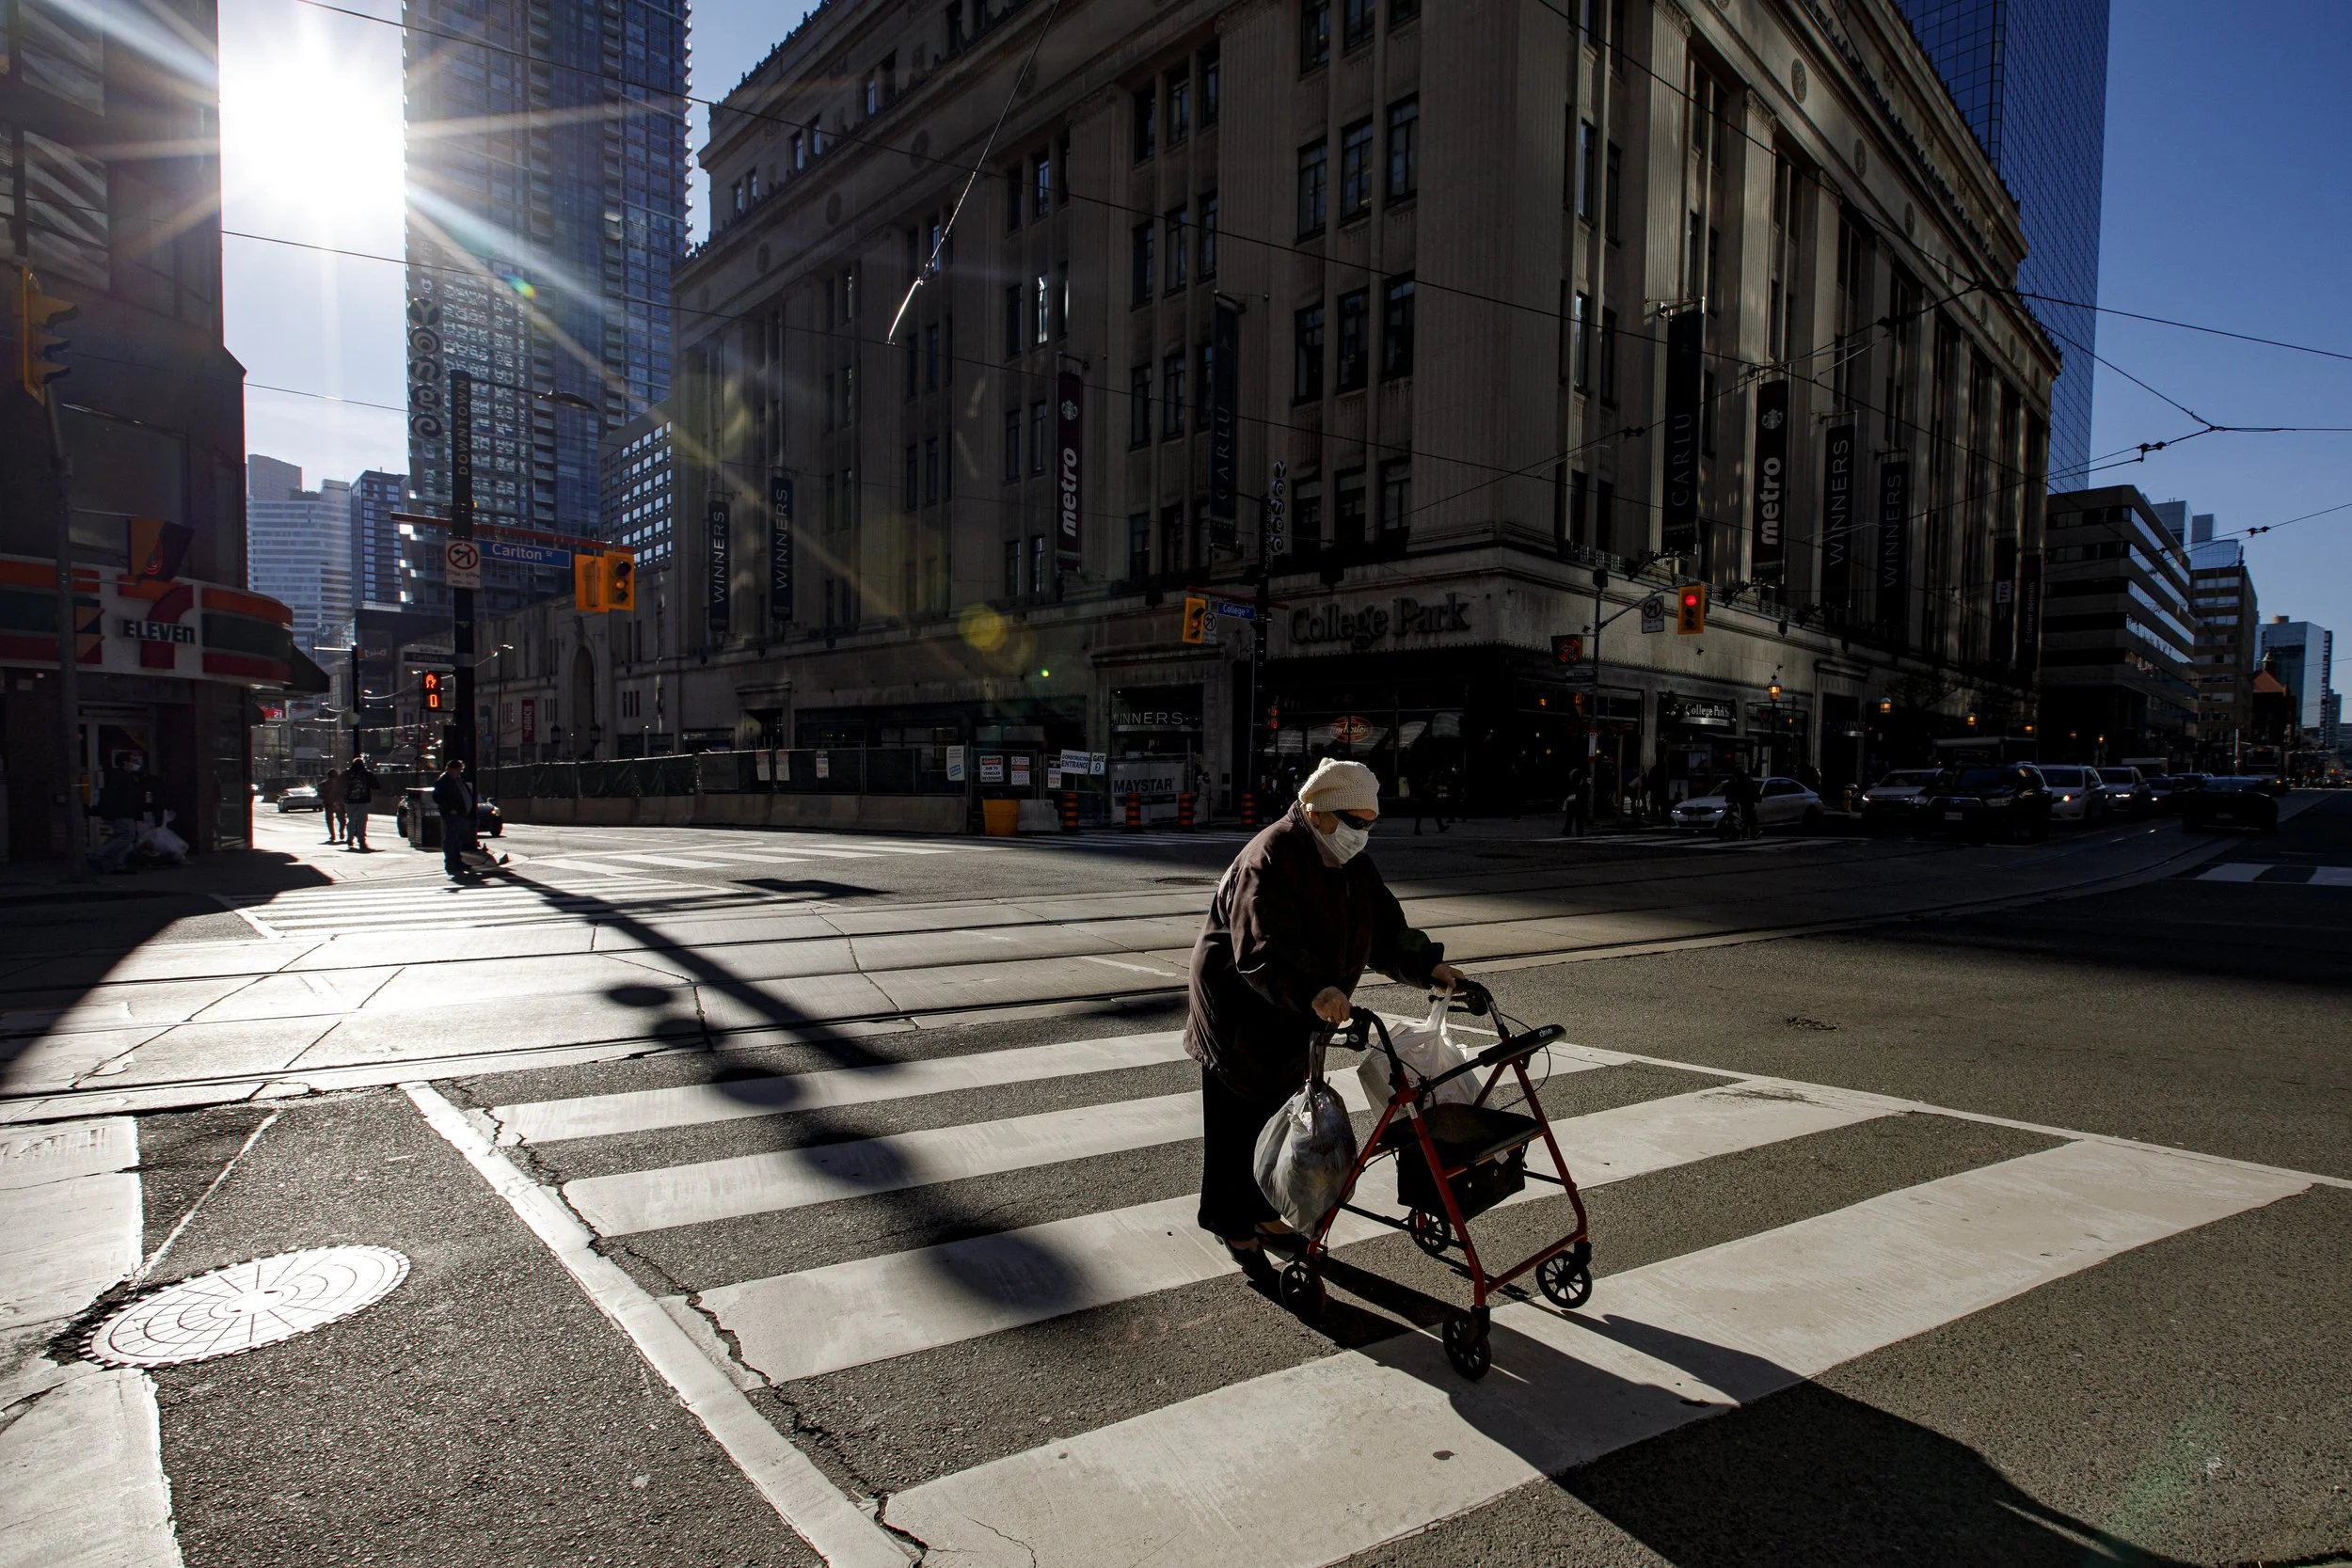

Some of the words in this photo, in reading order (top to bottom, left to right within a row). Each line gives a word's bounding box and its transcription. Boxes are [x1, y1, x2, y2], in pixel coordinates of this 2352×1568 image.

[457, 379, 469, 475] DOWNTOWN
[1671, 413, 1692, 507] CARLU
[1061, 447, 1077, 538] metro
[1758, 456, 1782, 546] metro
[1829, 439, 1849, 567] WINNERS
[1883, 474, 1902, 587] WINNERS
[492, 544, 542, 561] Carlton
[713, 511, 725, 603] WINNERS
[775, 488, 788, 590] WINNERS
[1223, 604, 1246, 616] College
[1289, 604, 1389, 649] College
[1393, 593, 1471, 637] Park
[429, 693, 438, 707] 0
[1685, 704, 1713, 718] College
[1061, 760, 1089, 769] ENTRANCE
[1114, 778, 1172, 792] MAYSTAR
